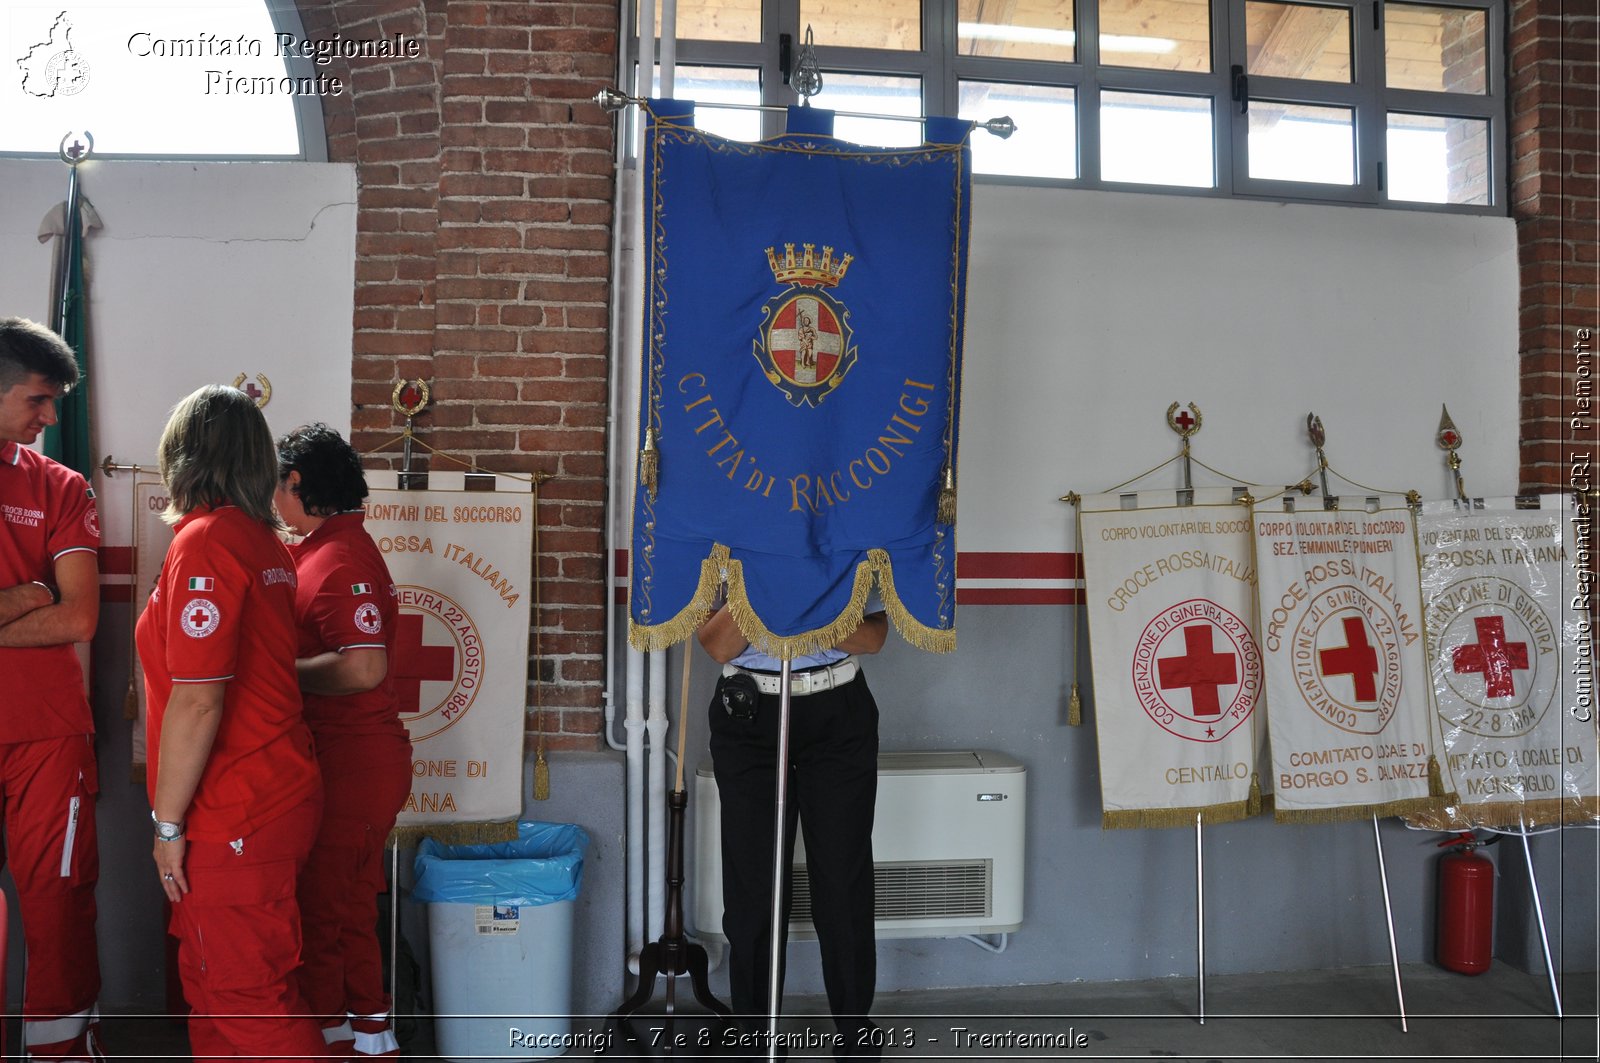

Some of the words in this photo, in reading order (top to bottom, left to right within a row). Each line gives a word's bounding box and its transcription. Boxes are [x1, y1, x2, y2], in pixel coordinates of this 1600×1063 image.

[787, 378, 935, 516] RACCONIGI
[24, 508, 45, 520] ROSSA
[148, 495, 170, 511] COR
[361, 504, 420, 522] LONTARI
[424, 506, 449, 523] DEL
[453, 506, 522, 524] SOCCORSO
[5, 513, 39, 528] ITALIANA
[1102, 526, 1137, 542] CORPO
[1140, 521, 1197, 539] VOLONTARI
[1197, 521, 1215, 535] DEL
[1215, 518, 1250, 535] SOCCO
[1258, 521, 1293, 537] CORPO
[1484, 527, 1504, 541] DEL
[1272, 541, 1299, 556] SEZ.
[1501, 545, 1569, 565] ITALIANA
[378, 535, 434, 555] OSSA
[443, 543, 520, 609] ITALIANA
[1107, 563, 1158, 612] CROCE
[1155, 550, 1210, 577] ROSSA
[1211, 554, 1258, 587] ITALIA
[443, 607, 463, 626] 22
[1170, 603, 1222, 624] GINEVRA
[1266, 581, 1308, 652] CROCE
[1360, 565, 1419, 647] ITALIANA
[1498, 584, 1512, 604] DI
[1515, 594, 1554, 656] GINEVRA
[1155, 618, 1171, 633] DI
[1223, 618, 1240, 635] 22
[457, 625, 480, 689] AGOSTO
[1236, 632, 1258, 690] AGOSTO
[1136, 630, 1174, 726] CONVENZIONE
[1296, 626, 1357, 728] CONVENZIONE
[1376, 618, 1393, 638] 22
[1385, 642, 1399, 698] AGOSTO
[441, 692, 470, 721] 1864
[1230, 693, 1254, 720] 1864
[1289, 745, 1374, 767] COMITATO
[1413, 742, 1426, 757] DI
[1513, 747, 1561, 768] LOCALE
[1566, 745, 1584, 765] DI
[467, 760, 487, 778] DI
[1165, 761, 1248, 785] CENTALLO
[1280, 769, 1349, 789] BORGO
[1356, 767, 1374, 784] S.
[1377, 762, 1429, 781] DALMAZZ
